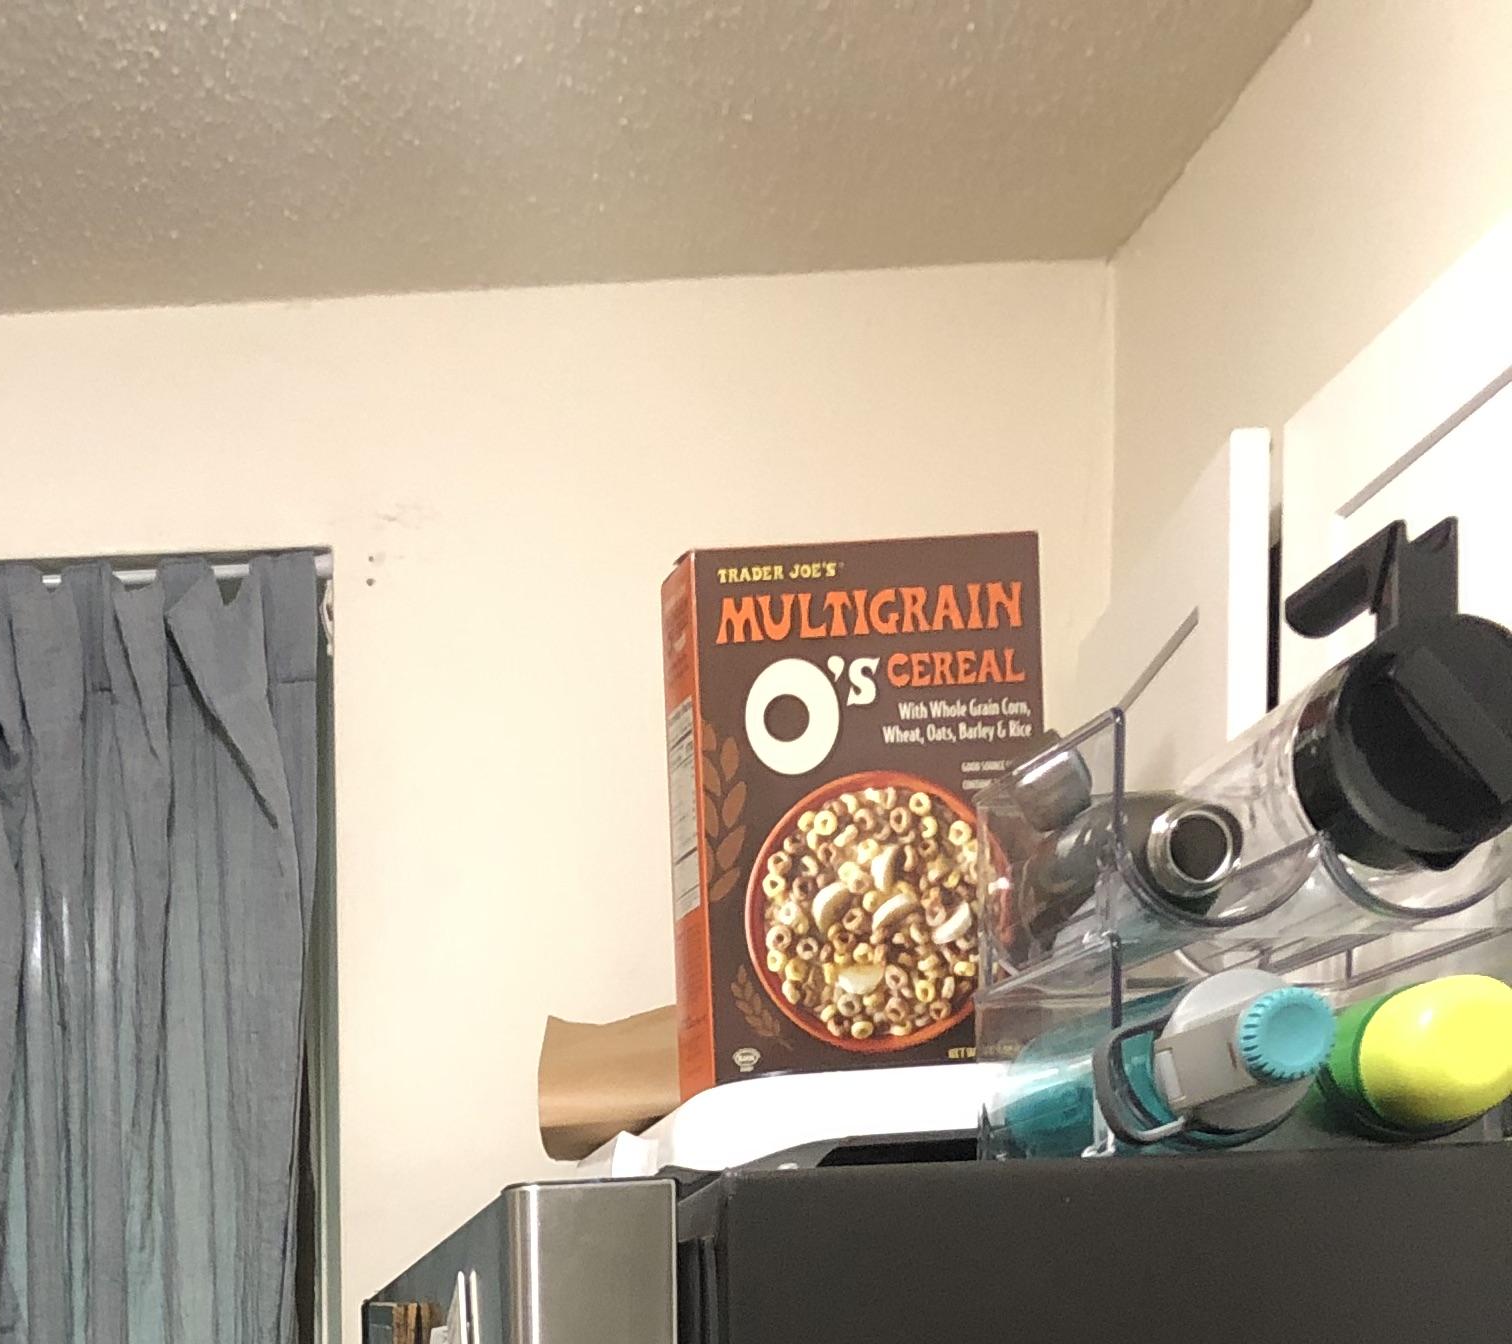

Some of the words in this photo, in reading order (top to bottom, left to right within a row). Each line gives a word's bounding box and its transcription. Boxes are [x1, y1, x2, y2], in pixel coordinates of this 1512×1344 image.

[717, 565, 784, 584] TRADER
[789, 562, 837, 579] JOE'S
[716, 581, 1023, 645] MULTIGRAIN
[745, 655, 880, 775] O'S
[887, 648, 1026, 688] CEREAL
[898, 701, 928, 720] With
[929, 699, 967, 719] Whole
[969, 698, 1000, 717] Grain
[1001, 696, 1031, 716] Corn,
[882, 726, 924, 745] Wheat,
[926, 723, 956, 743] Oats,
[958, 720, 994, 742] Barley
[997, 720, 1006, 738] &
[1009, 718, 1032, 738] Rice
